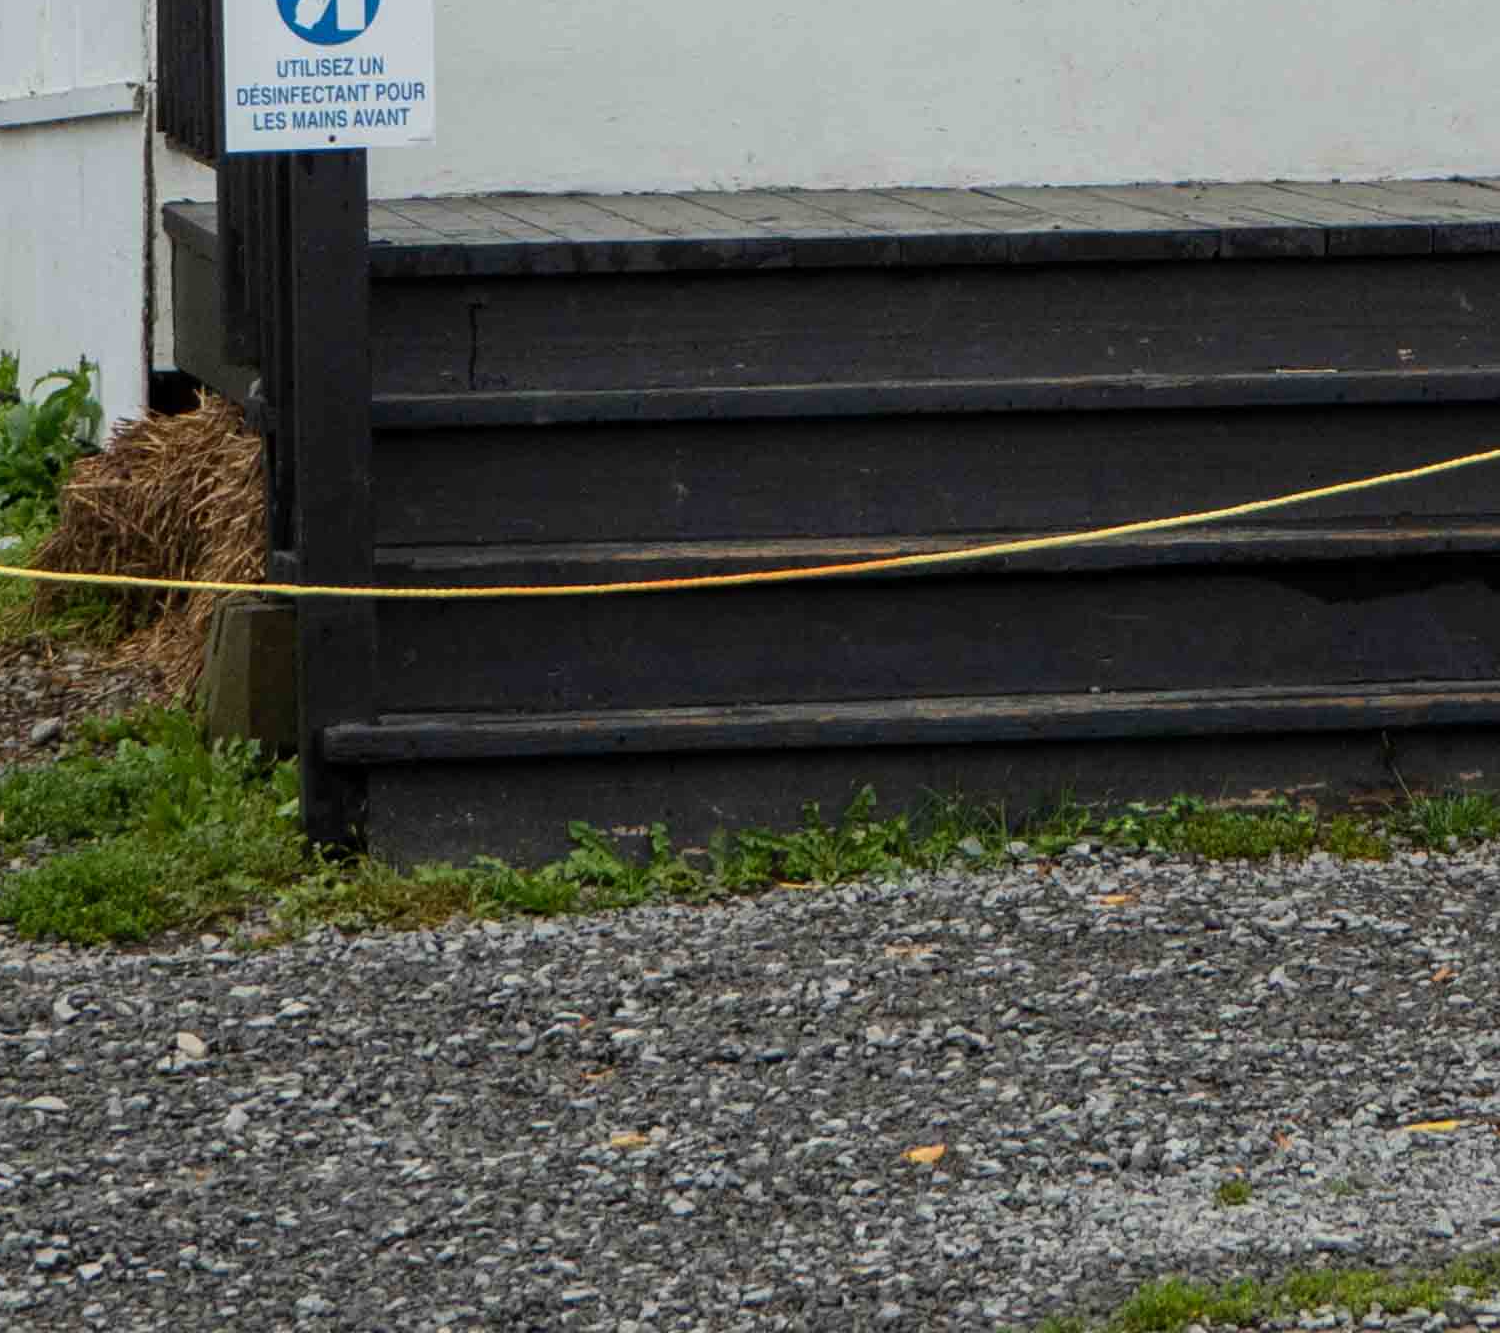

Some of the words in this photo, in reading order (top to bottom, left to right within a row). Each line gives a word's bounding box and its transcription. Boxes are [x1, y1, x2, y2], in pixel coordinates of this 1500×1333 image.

[277, 58, 354, 79] UTILISEZ
[359, 56, 384, 76] UN
[236, 82, 371, 107] DÉSINFECTANT
[375, 82, 425, 102] POUR
[252, 111, 286, 131] LES
[291, 110, 348, 129] MAINS
[353, 107, 411, 128] AVANT
